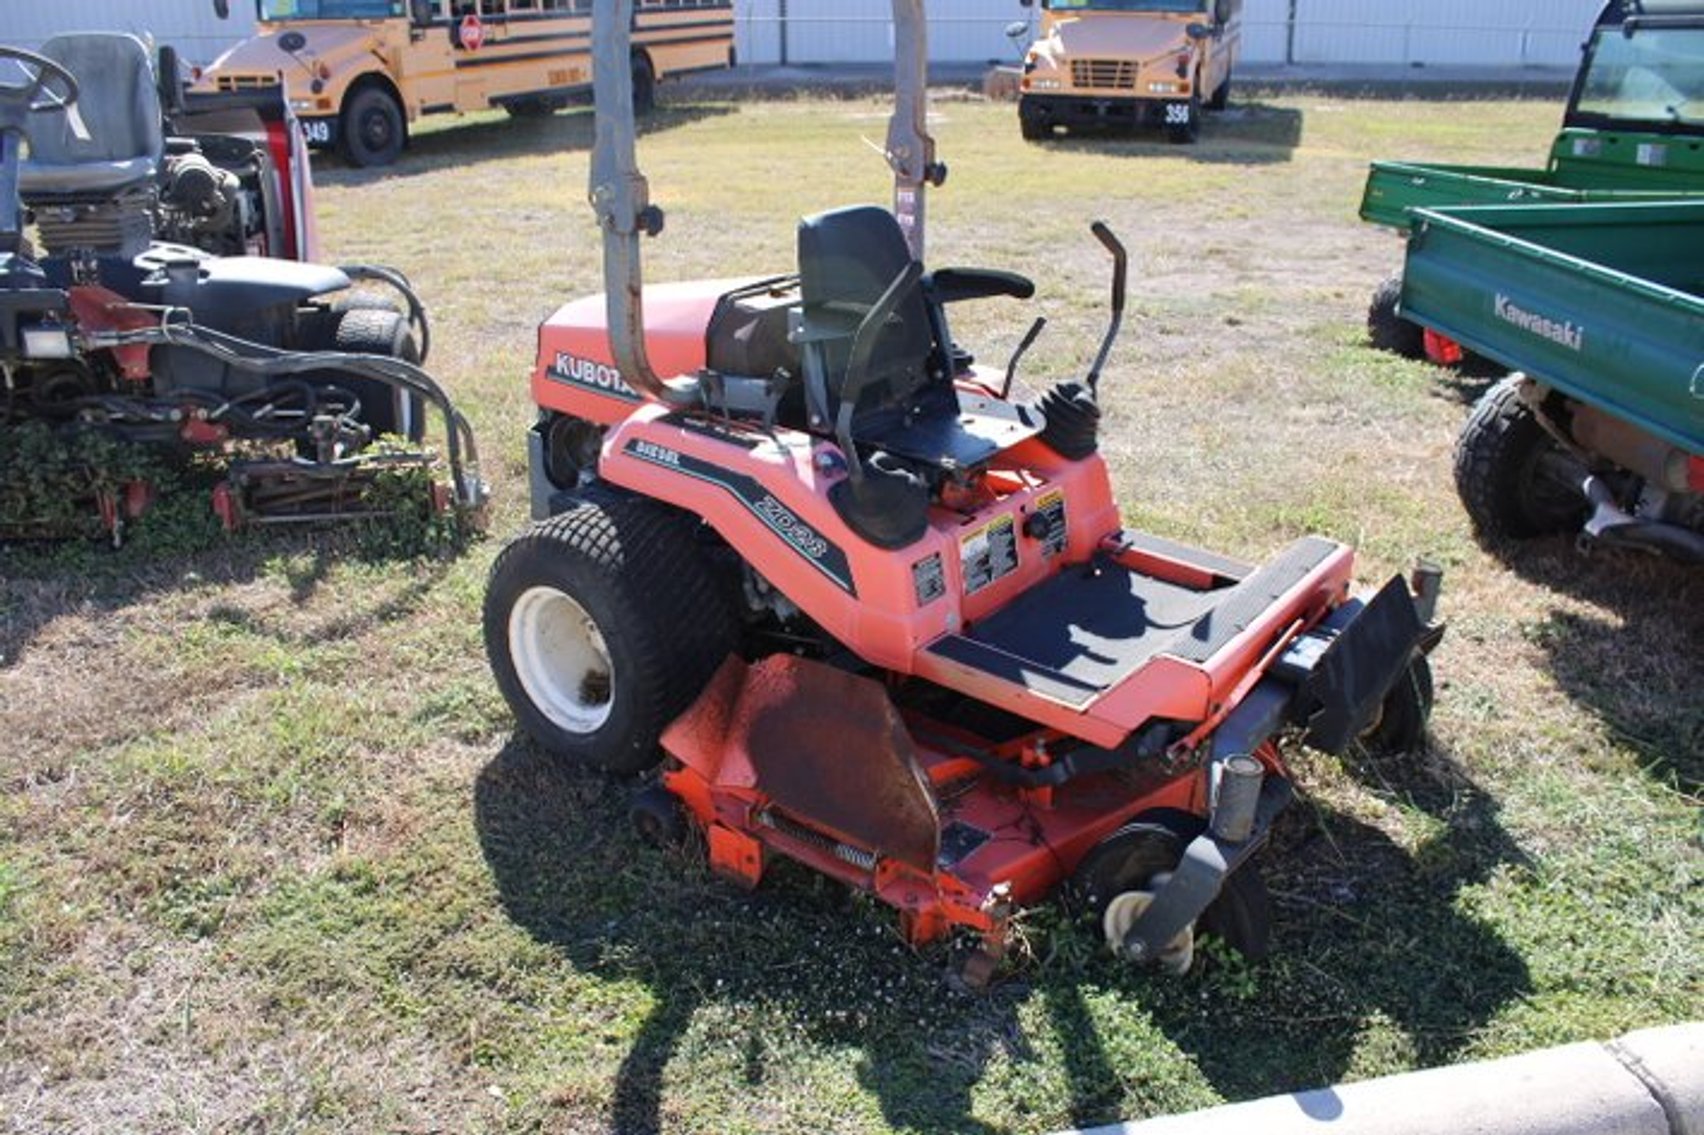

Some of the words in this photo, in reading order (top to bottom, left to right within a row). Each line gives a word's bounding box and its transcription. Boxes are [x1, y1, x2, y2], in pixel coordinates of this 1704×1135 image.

[1166, 103, 1189, 123] 356
[1494, 292, 1584, 351] Kawasaki
[636, 441, 680, 465] DIESEL
